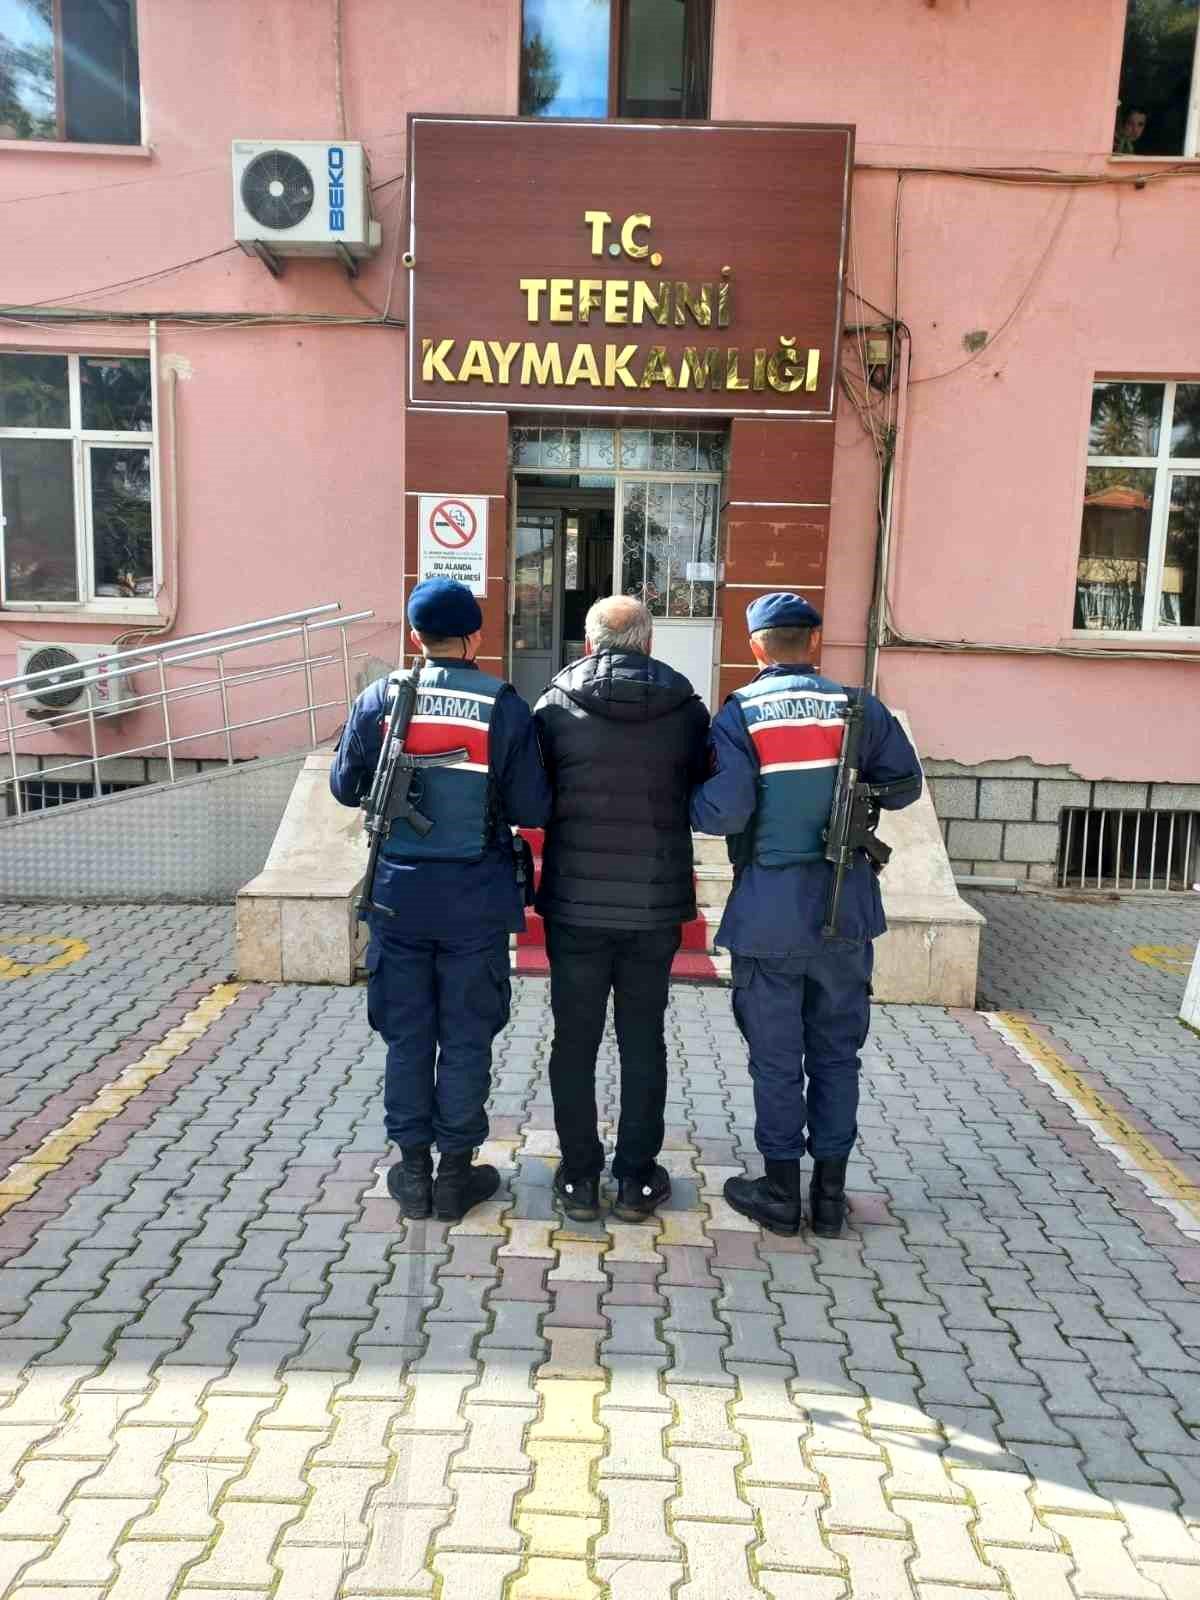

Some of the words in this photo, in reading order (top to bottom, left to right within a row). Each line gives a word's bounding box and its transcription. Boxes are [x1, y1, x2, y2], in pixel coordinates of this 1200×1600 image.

[328, 147, 344, 231] BEKO
[584, 210, 663, 267] T.C.
[519, 265, 734, 328] TEFENNİ
[421, 335, 820, 393] KAYMAKAMLIĞI
[433, 562, 444, 571] BU
[445, 562, 472, 571] ALANDA
[756, 697, 839, 721] JANDARMA
